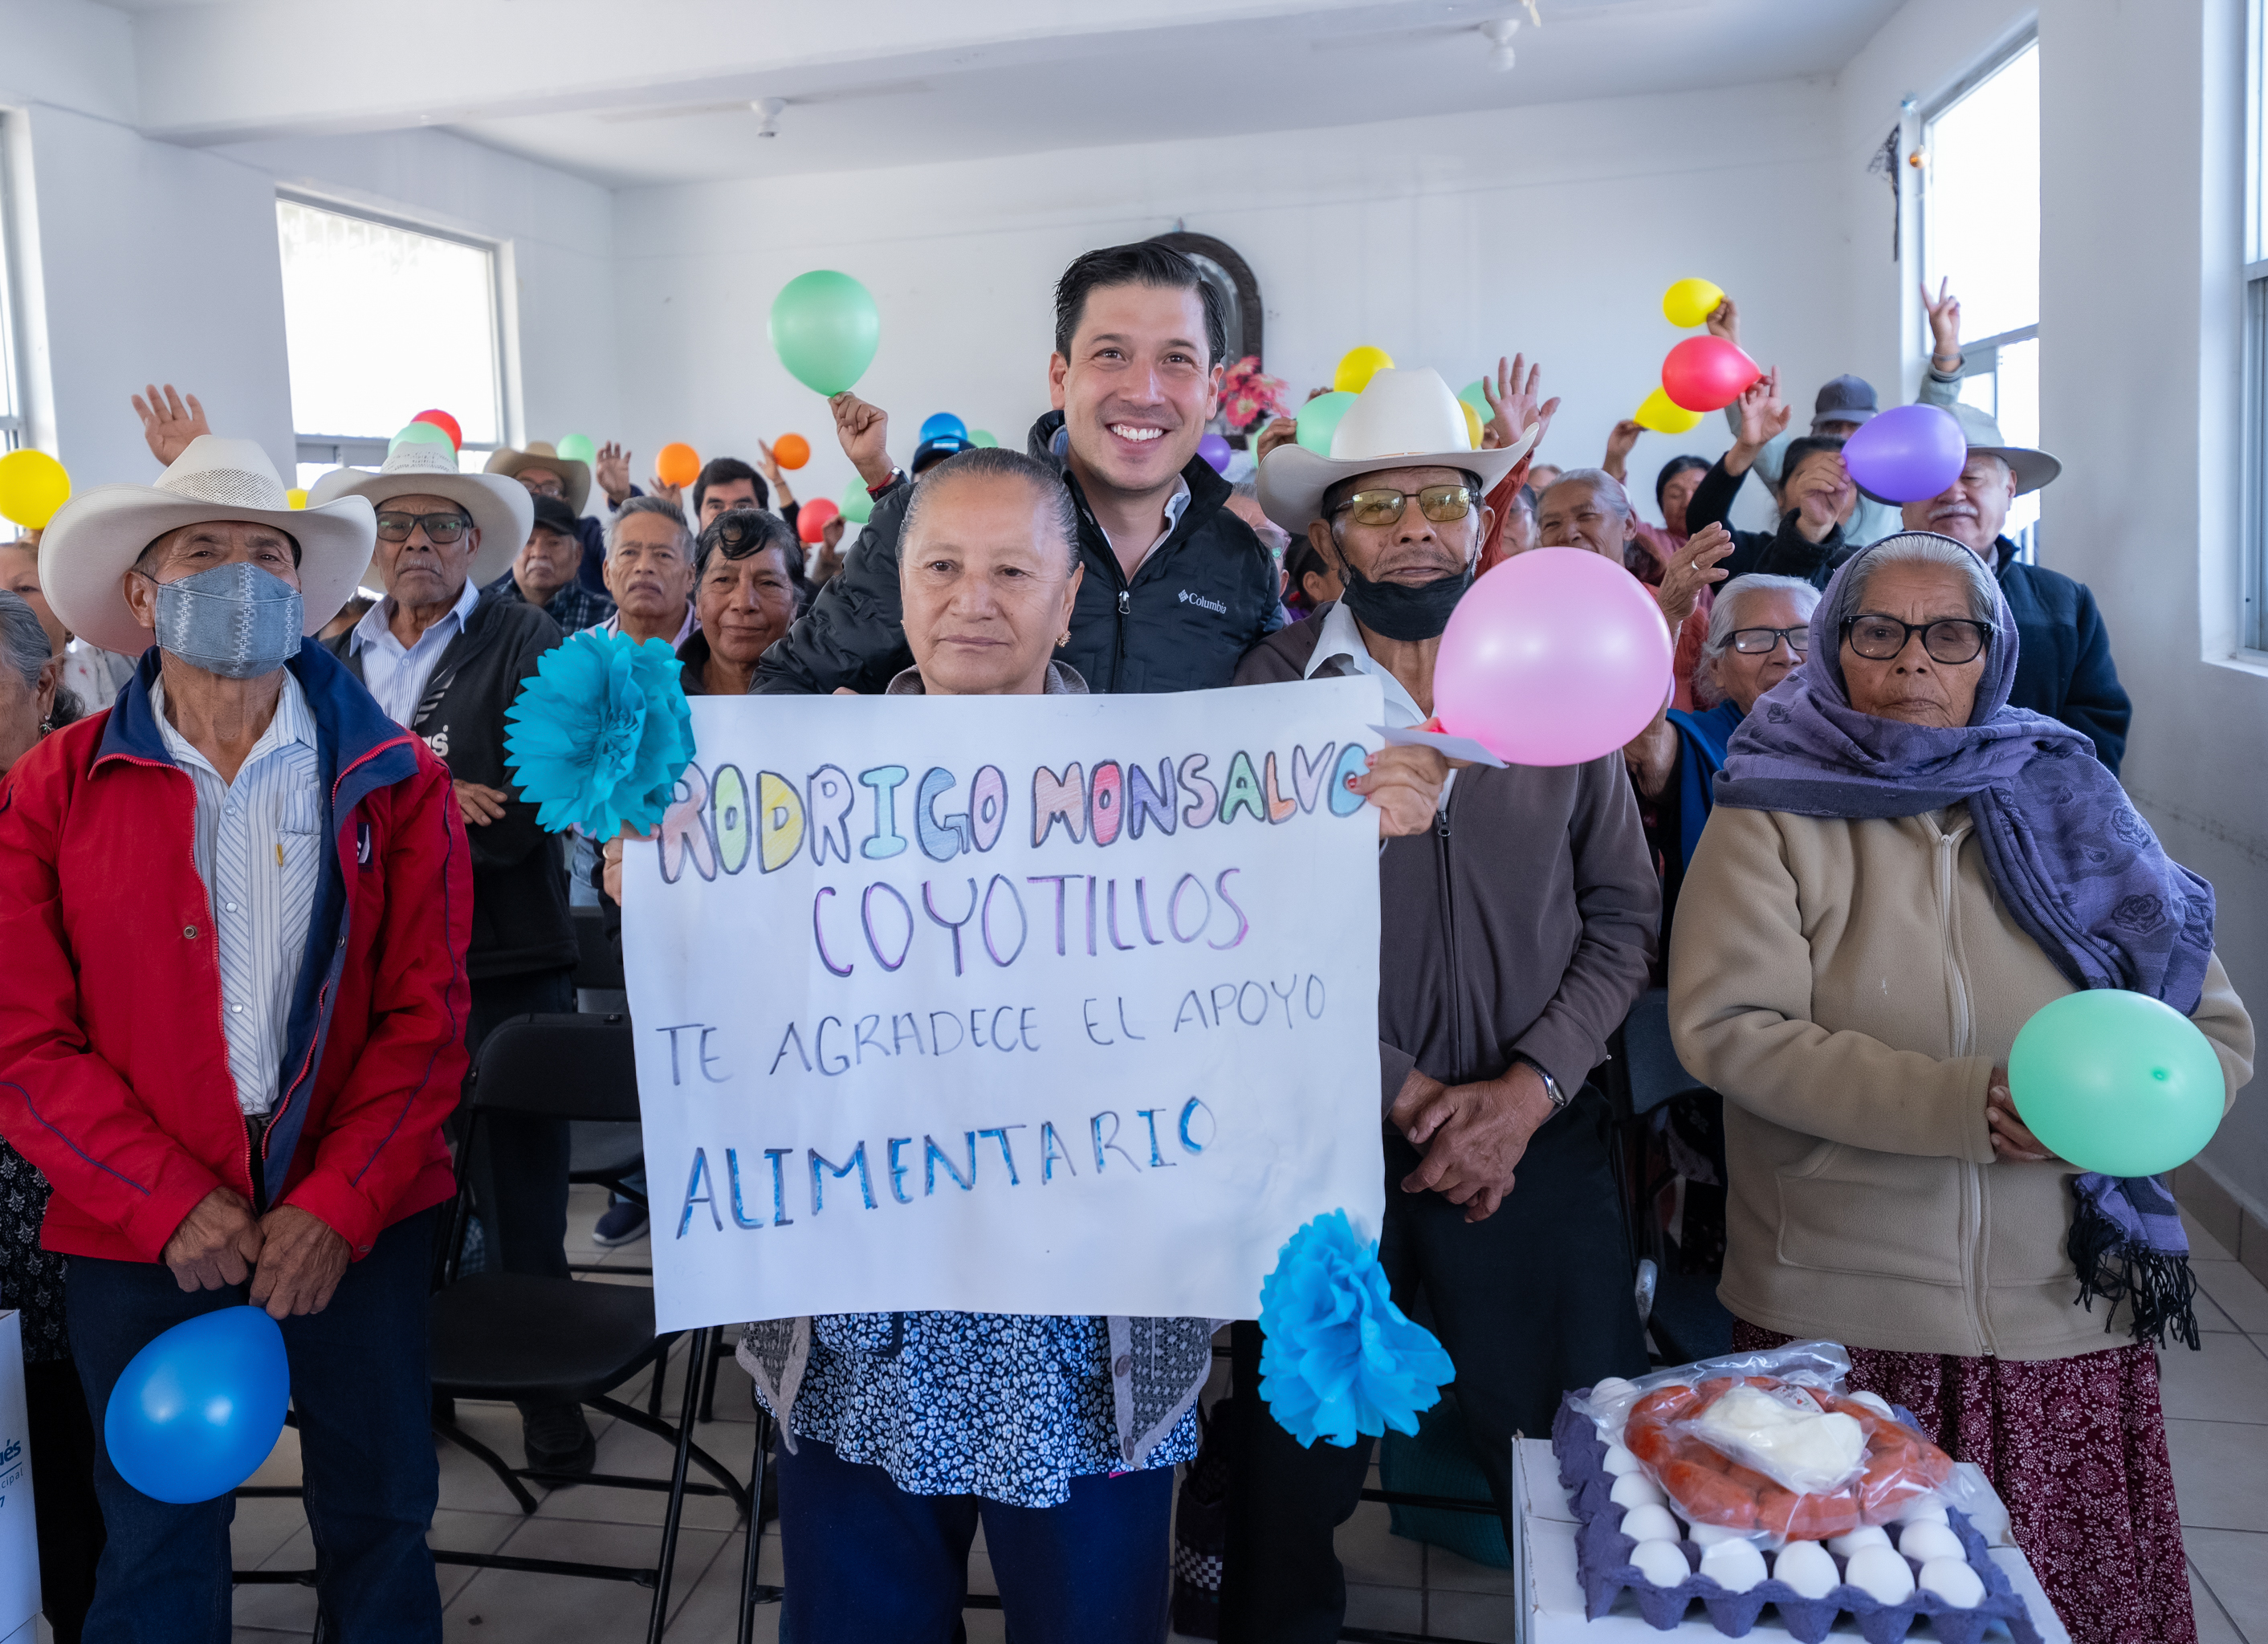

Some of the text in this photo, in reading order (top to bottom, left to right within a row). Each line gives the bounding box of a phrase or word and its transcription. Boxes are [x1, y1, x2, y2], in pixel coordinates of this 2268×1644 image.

[1189, 592, 1227, 614] Columbia
[658, 742, 1368, 883] RODRIGO MONSALVO
[813, 869, 1249, 976] COYOTILLOS
[657, 974, 1325, 1085] TE AGRADECE EL APOYO
[676, 1097, 1215, 1240] ALIMENTARIO
